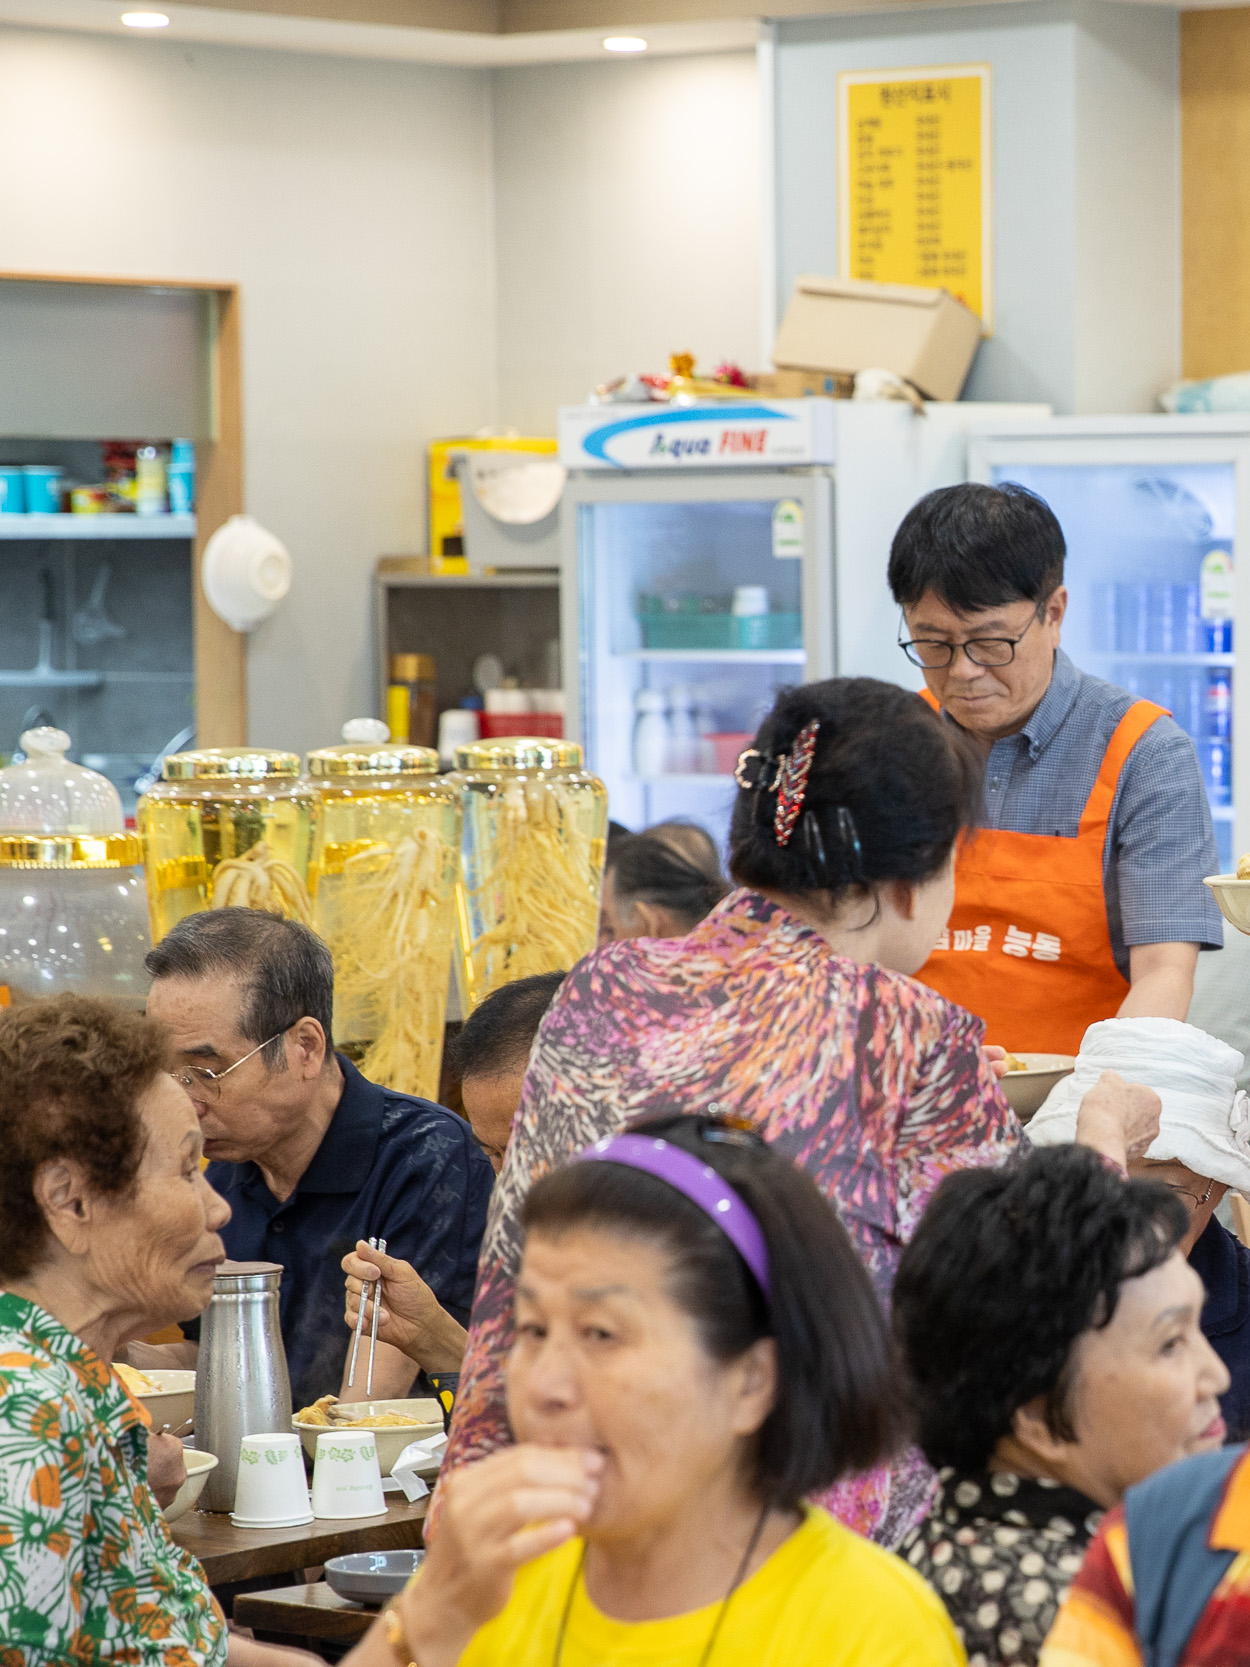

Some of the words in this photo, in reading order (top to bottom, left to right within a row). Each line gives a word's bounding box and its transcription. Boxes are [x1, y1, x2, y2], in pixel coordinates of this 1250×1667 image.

[650, 432, 711, 458] Aqua
[719, 430, 768, 454] FINE
[1002, 924, 1061, 962] 능동
